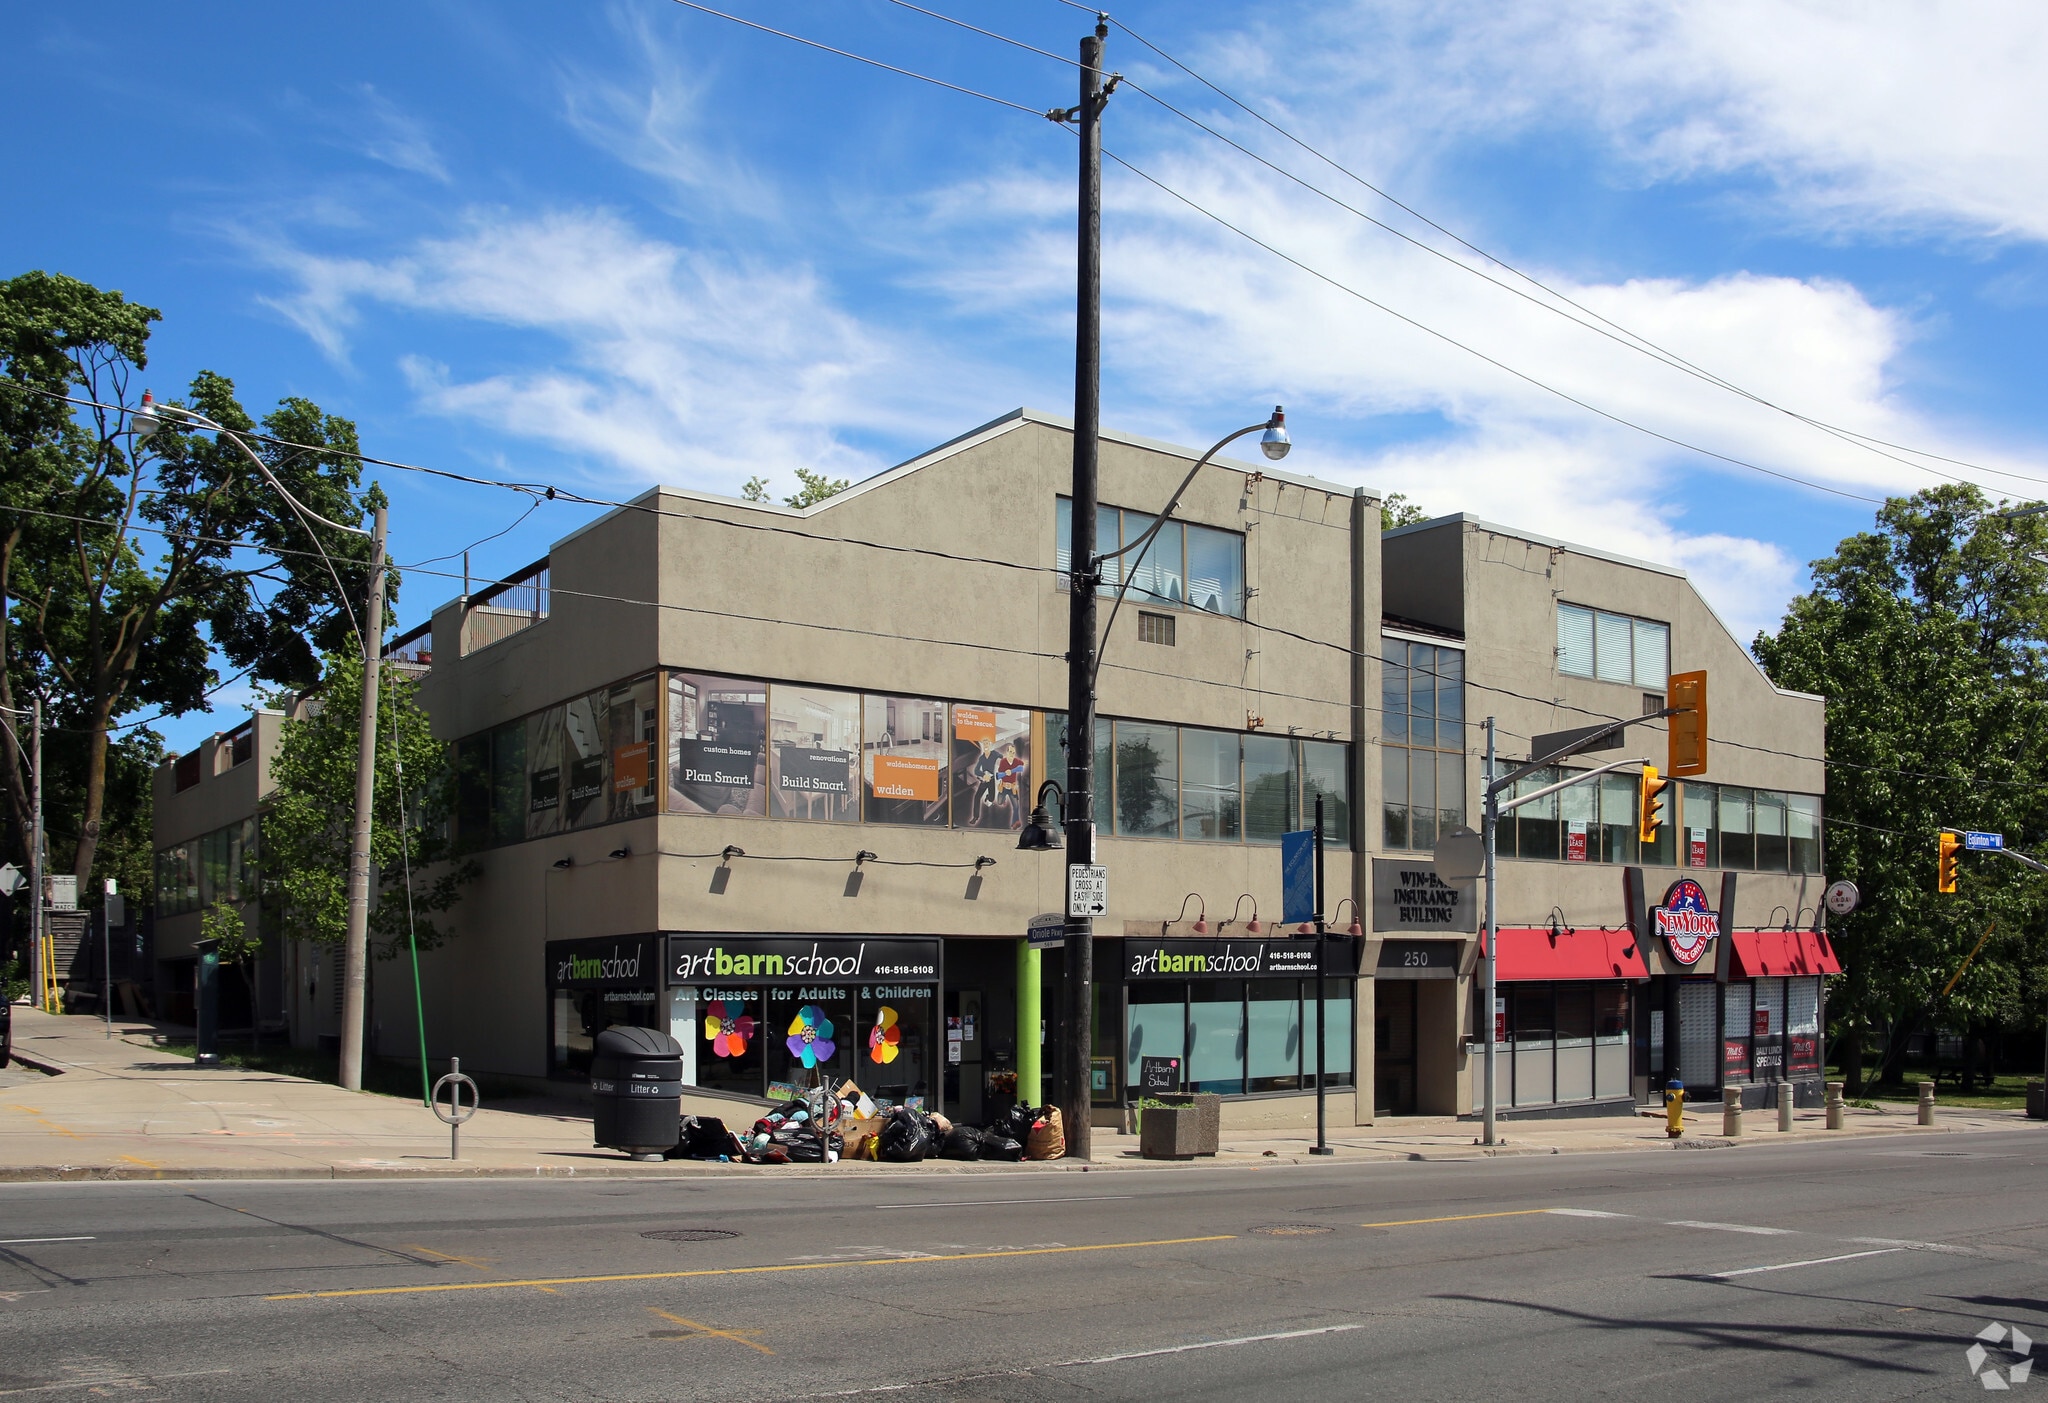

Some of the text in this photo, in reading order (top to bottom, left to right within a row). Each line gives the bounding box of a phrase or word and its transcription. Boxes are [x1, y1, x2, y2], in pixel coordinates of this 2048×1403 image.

[957, 711, 979, 720] walden
[703, 746, 751, 756] custom homes
[809, 754, 847, 764] renovations
[886, 760, 936, 771] waldenhomes.ca
[685, 768, 752, 786] Plan Smart.
[781, 775, 847, 792] Build Smart.
[876, 784, 914, 797] walden
[1968, 833, 1990, 848] Eglinton
[1072, 868, 1105, 879] PEDESTRIANS
[1075, 880, 1103, 890] CROSS AT
[1092, 891, 1103, 901] SIDE
[1393, 888, 1459, 906] INSURANCE
[1072, 902, 1087, 912] ONLY
[1399, 906, 1453, 923] BUILDING
[1032, 928, 1063, 939] Oriole Pkwy
[1670, 938, 1705, 961] CLASSIC GRILL
[676, 942, 865, 979] artbarnschool
[1131, 944, 1264, 976] artbarnschool
[1269, 952, 1312, 960] 416-518-6108
[1404, 951, 1428, 966] 250
[557, 943, 642, 983] artbarnschool
[1269, 962, 1318, 971] artbarnschool.co
[874, 965, 934, 975] 416-518-6108
[603, 990, 656, 1002] artbarnschool.com
[675, 986, 932, 1001] Art Classes for Adults & Children
[1756, 1045, 1782, 1056] DAILY LUNCH
[1144, 1060, 1175, 1073] Artbarn
[1756, 1055, 1782, 1068] SPECIALS
[600, 1081, 614, 1091] Litter
[1148, 1073, 1170, 1087] School
[631, 1083, 650, 1094] Litter
